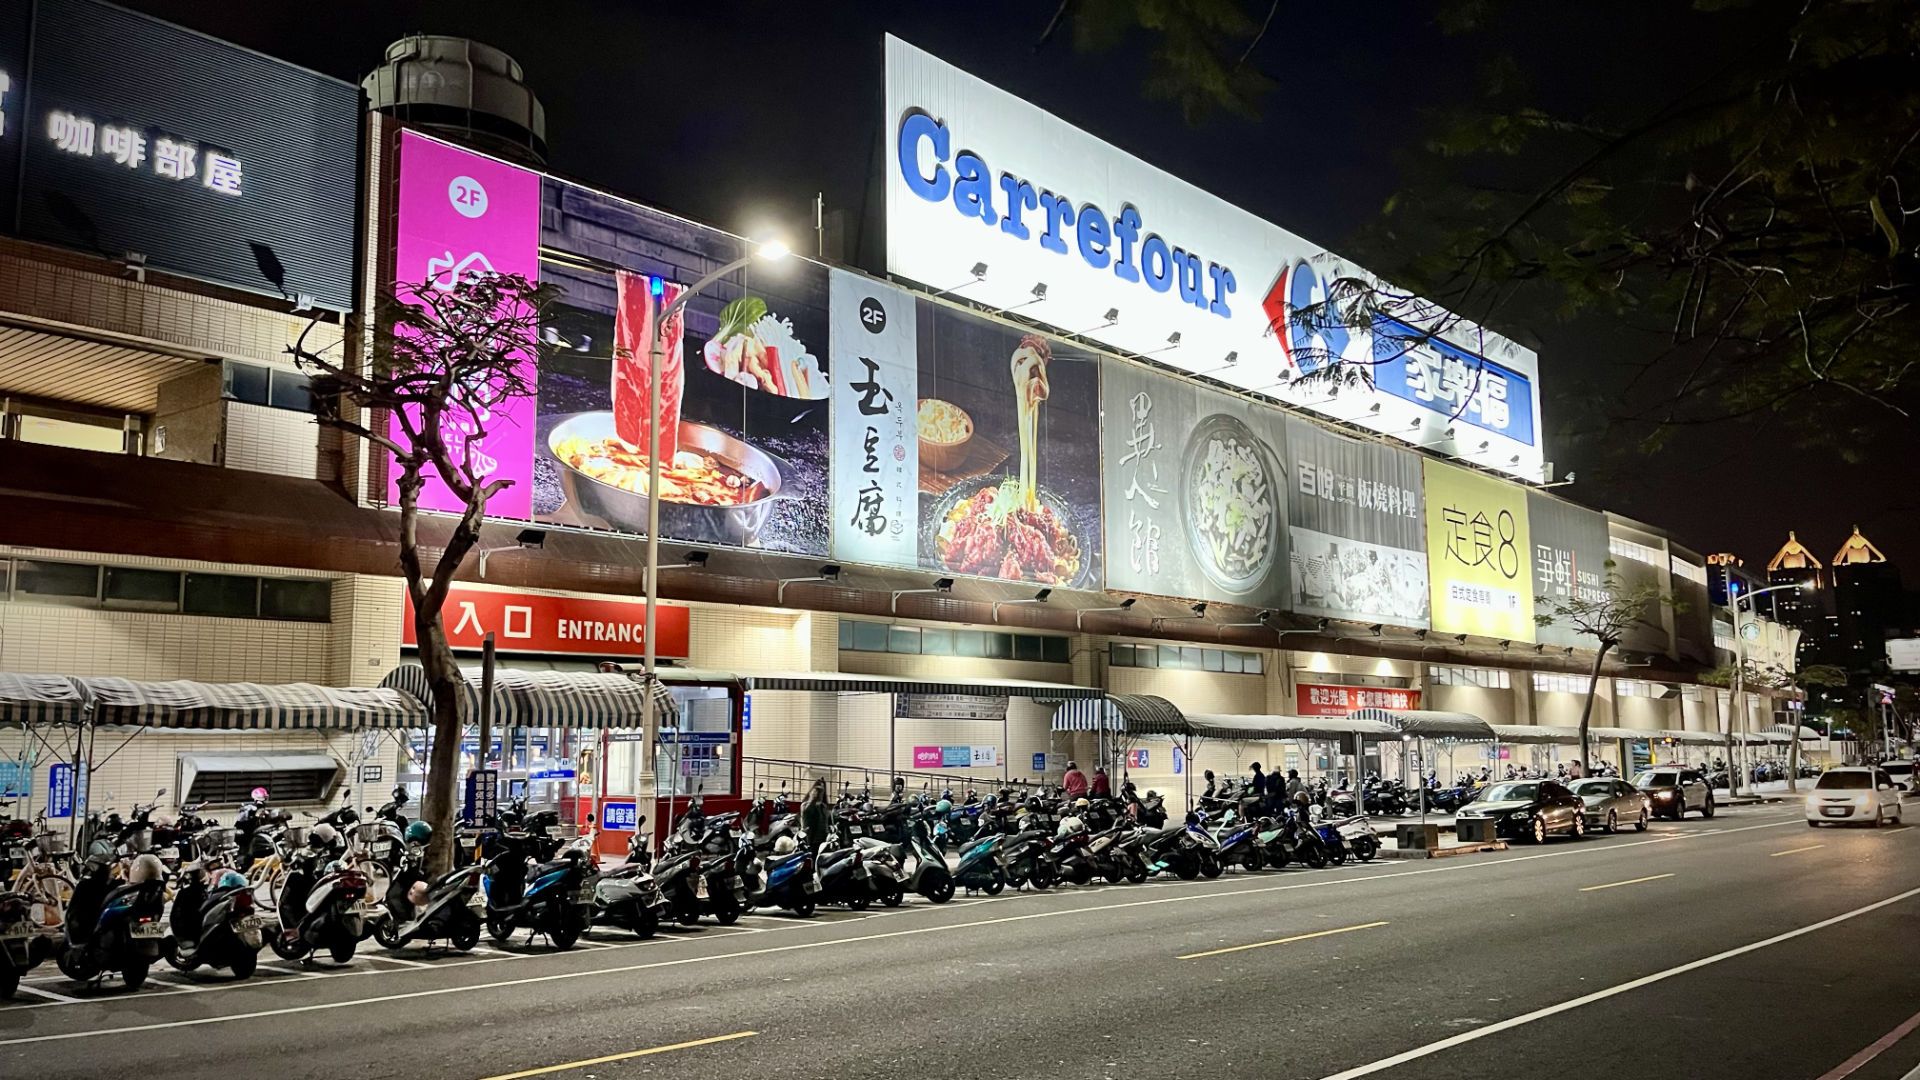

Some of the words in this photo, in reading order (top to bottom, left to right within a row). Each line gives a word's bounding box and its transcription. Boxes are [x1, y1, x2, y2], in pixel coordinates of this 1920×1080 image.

[48, 111, 243, 197] 咖啡部屋
[456, 185, 481, 207] 2F
[898, 107, 1237, 319] Carrefour
[862, 306, 884, 326] 2F
[1405, 343, 1510, 430] 家樂福
[849, 356, 894, 536] 玉豆腐
[1358, 477, 1417, 519] 板燒料理
[1442, 504, 1518, 579] 定食8
[1577, 570, 1599, 587] SUSHI
[1578, 586, 1611, 605] EXPRESS
[453, 601, 532, 639] 入口
[558, 618, 647, 643] ENTRANC
